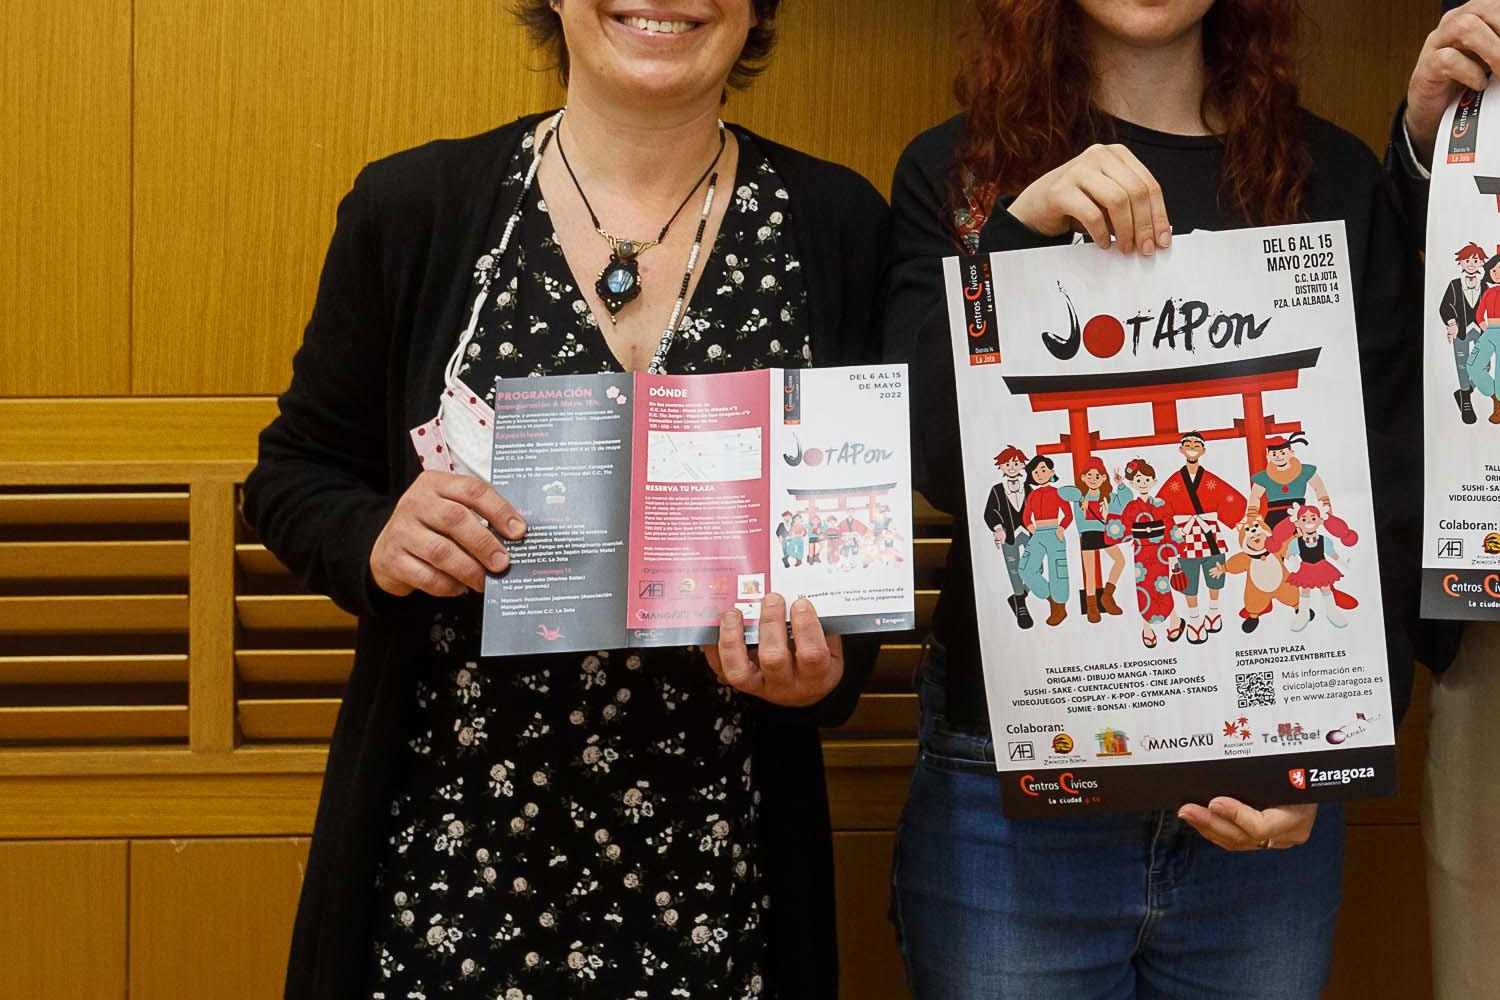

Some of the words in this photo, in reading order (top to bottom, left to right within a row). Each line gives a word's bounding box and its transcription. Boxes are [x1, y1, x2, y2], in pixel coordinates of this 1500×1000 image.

[1263, 238, 1286, 254] DEL
[1288, 237, 1296, 252] 6
[1300, 236, 1315, 251] AL
[1318, 234, 1332, 249] 15
[1267, 255, 1300, 272] MAYO
[1303, 252, 1335, 269] 2022
[497, 388, 592, 400] PROGRAMACIÓN
[649, 386, 689, 398] DÓNDE
[690, 484, 715, 492] PLAZA
[1439, 520, 1497, 531] Colaboran:
[1442, 574, 1483, 598] Centros
[1084, 663, 1118, 672] CHARLAS
[1124, 658, 1178, 668] EXPOSICIONES
[1047, 676, 1082, 685] ORIGAMI
[1087, 673, 1116, 682] DIBUJO
[1118, 671, 1148, 679] MANGA
[1153, 668, 1176, 676] TAIKO
[1078, 681, 1145, 693] CUENTACUENTOS
[1150, 679, 1169, 687] CINE
[1170, 675, 1205, 686] JAPONÉS
[1012, 697, 1066, 707] VIDEOJUEGOS
[1072, 694, 1106, 703] COSPLAY
[1112, 692, 1135, 700] K-POP
[1141, 689, 1182, 698] GYMKANA
[1187, 685, 1218, 694] STANDS
[1067, 706, 1092, 714] SUMIE
[1097, 703, 1127, 711] BONSAI
[1132, 700, 1166, 709] KIMONO
[1309, 767, 1375, 784] Zaragoza
